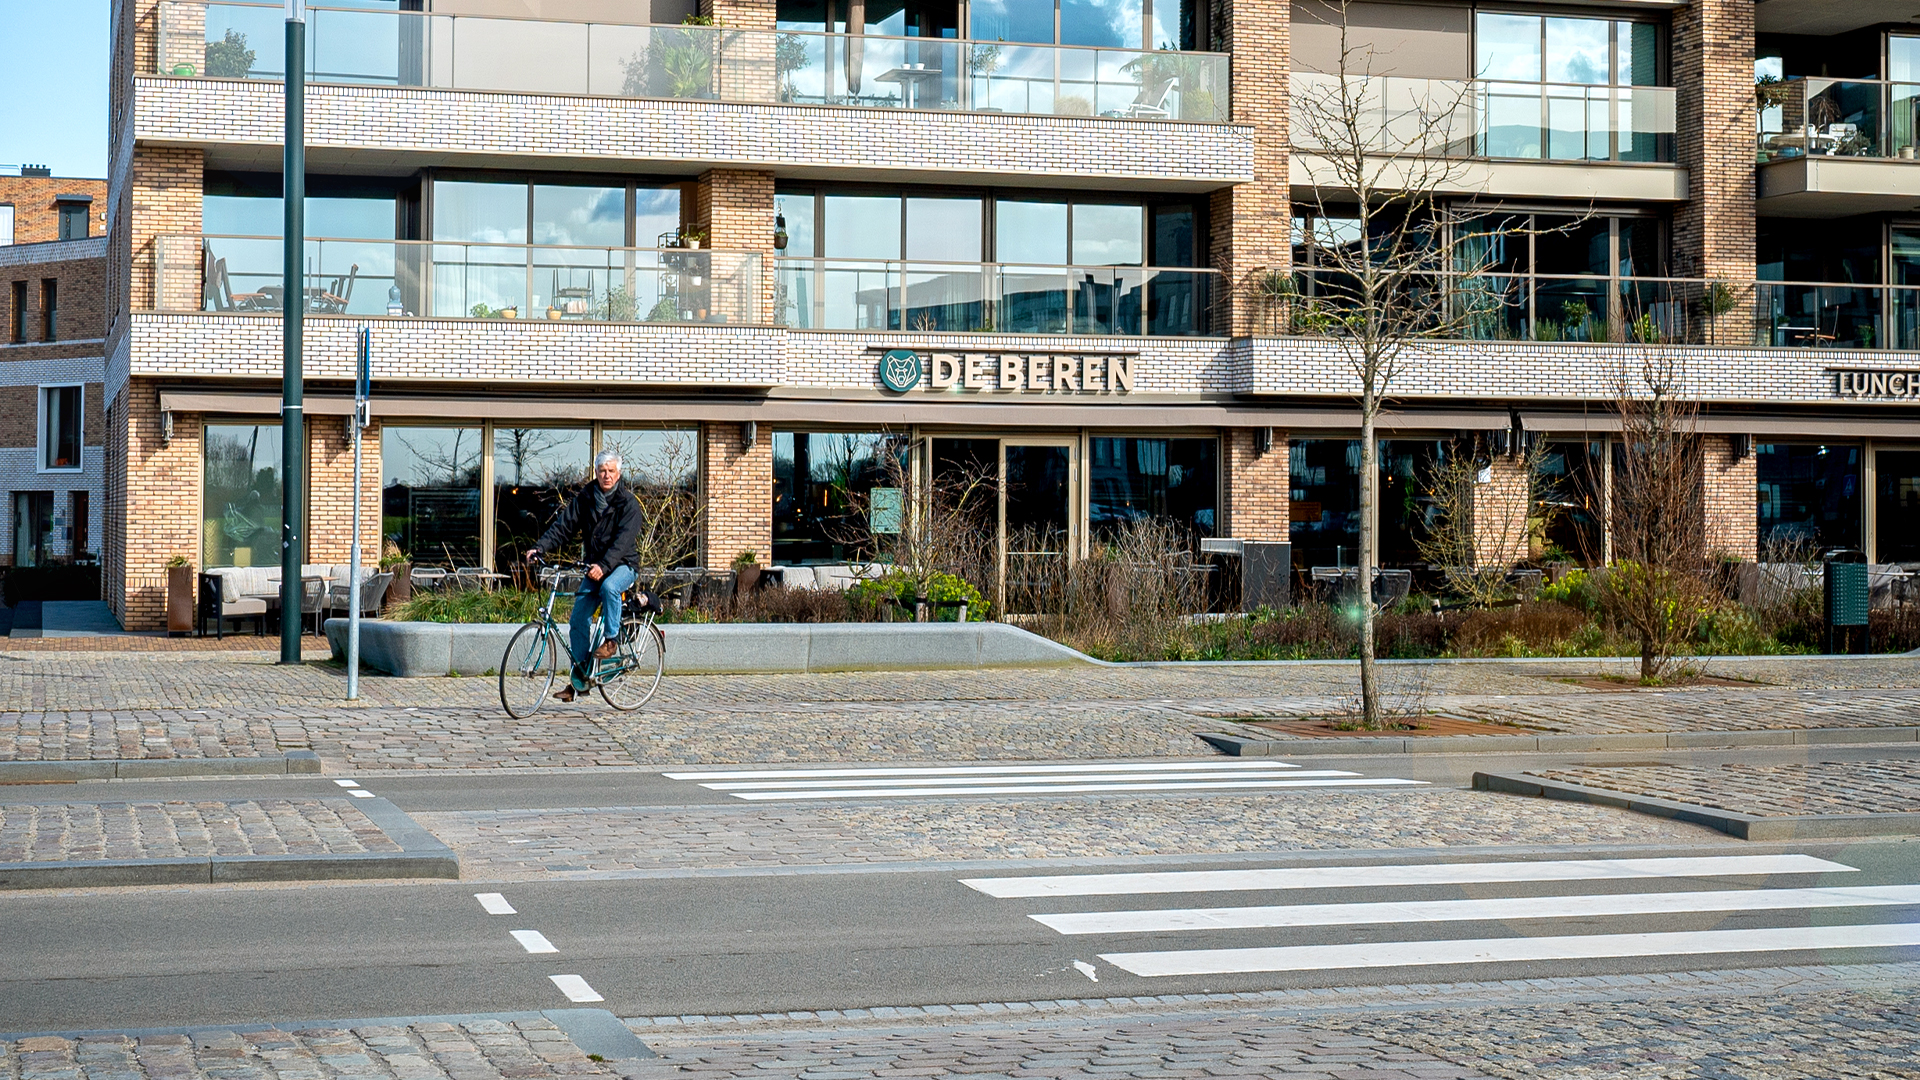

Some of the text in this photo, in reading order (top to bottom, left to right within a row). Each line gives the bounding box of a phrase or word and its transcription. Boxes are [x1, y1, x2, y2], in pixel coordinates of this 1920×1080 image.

[931, 353, 1135, 391] DE BEREN
[1839, 372, 1920, 395] LUNCH
